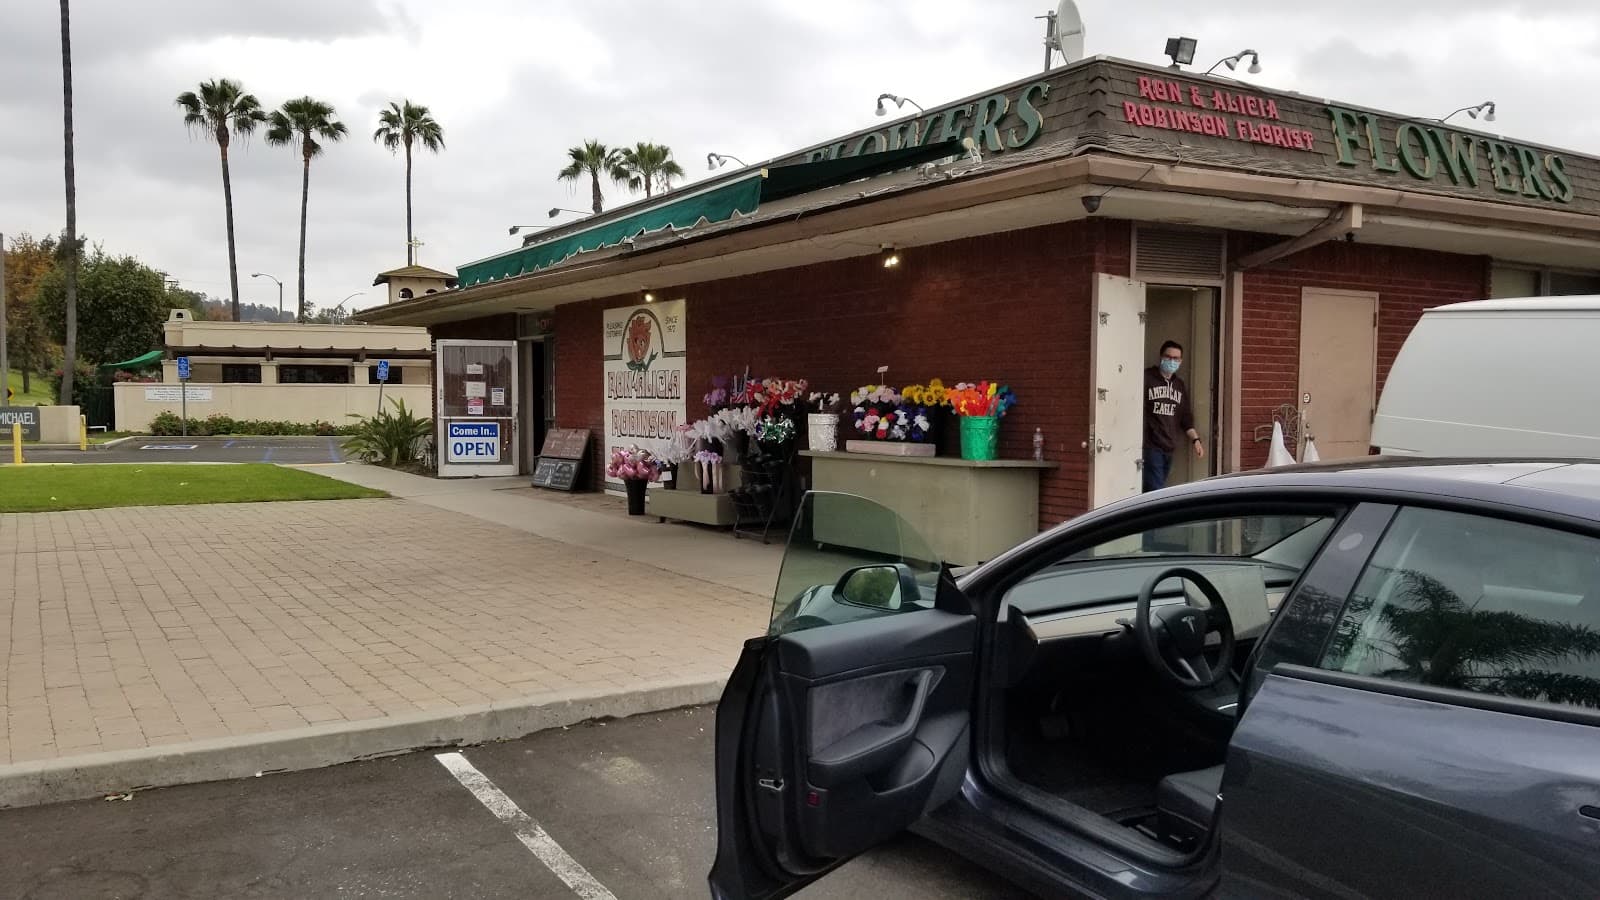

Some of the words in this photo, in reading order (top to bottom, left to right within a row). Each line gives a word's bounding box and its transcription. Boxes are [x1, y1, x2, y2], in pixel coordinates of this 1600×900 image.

[1138, 76, 1181, 102] RON
[1189, 86, 1206, 107] &
[1211, 90, 1280, 120] ALICIA
[1123, 101, 1229, 137] ROBINSON
[1235, 120, 1314, 150] FLORIST
[1328, 107, 1573, 203] FLOWERS
[1149, 386, 1182, 404] AMERICAN
[1153, 402, 1177, 415] EAGLE
[452, 426, 479, 436] Come
[612, 410, 676, 440] ROBINSON
[453, 442, 495, 456] OPEN
